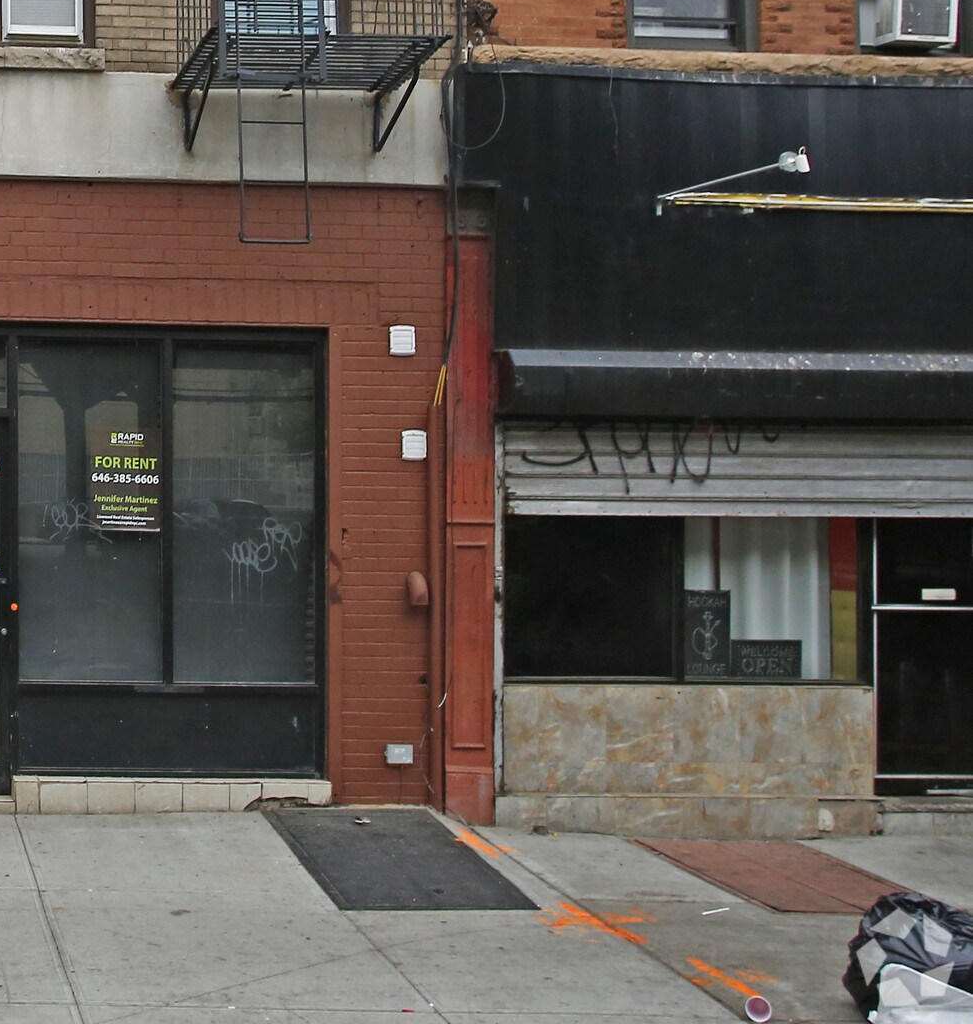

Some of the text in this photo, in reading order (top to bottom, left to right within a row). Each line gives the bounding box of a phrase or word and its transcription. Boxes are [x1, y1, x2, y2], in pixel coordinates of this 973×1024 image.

[117, 432, 144, 441] RAPID
[94, 456, 158, 471] FOR RENT
[91, 472, 160, 485] 646-385-6606
[93, 494, 158, 505] Jennifer Martinez
[101, 504, 148, 514] Exclusive Agent
[687, 596, 727, 608] HOOKAH
[687, 663, 726, 675] LOUNGE
[740, 657, 795, 674] OPEN
